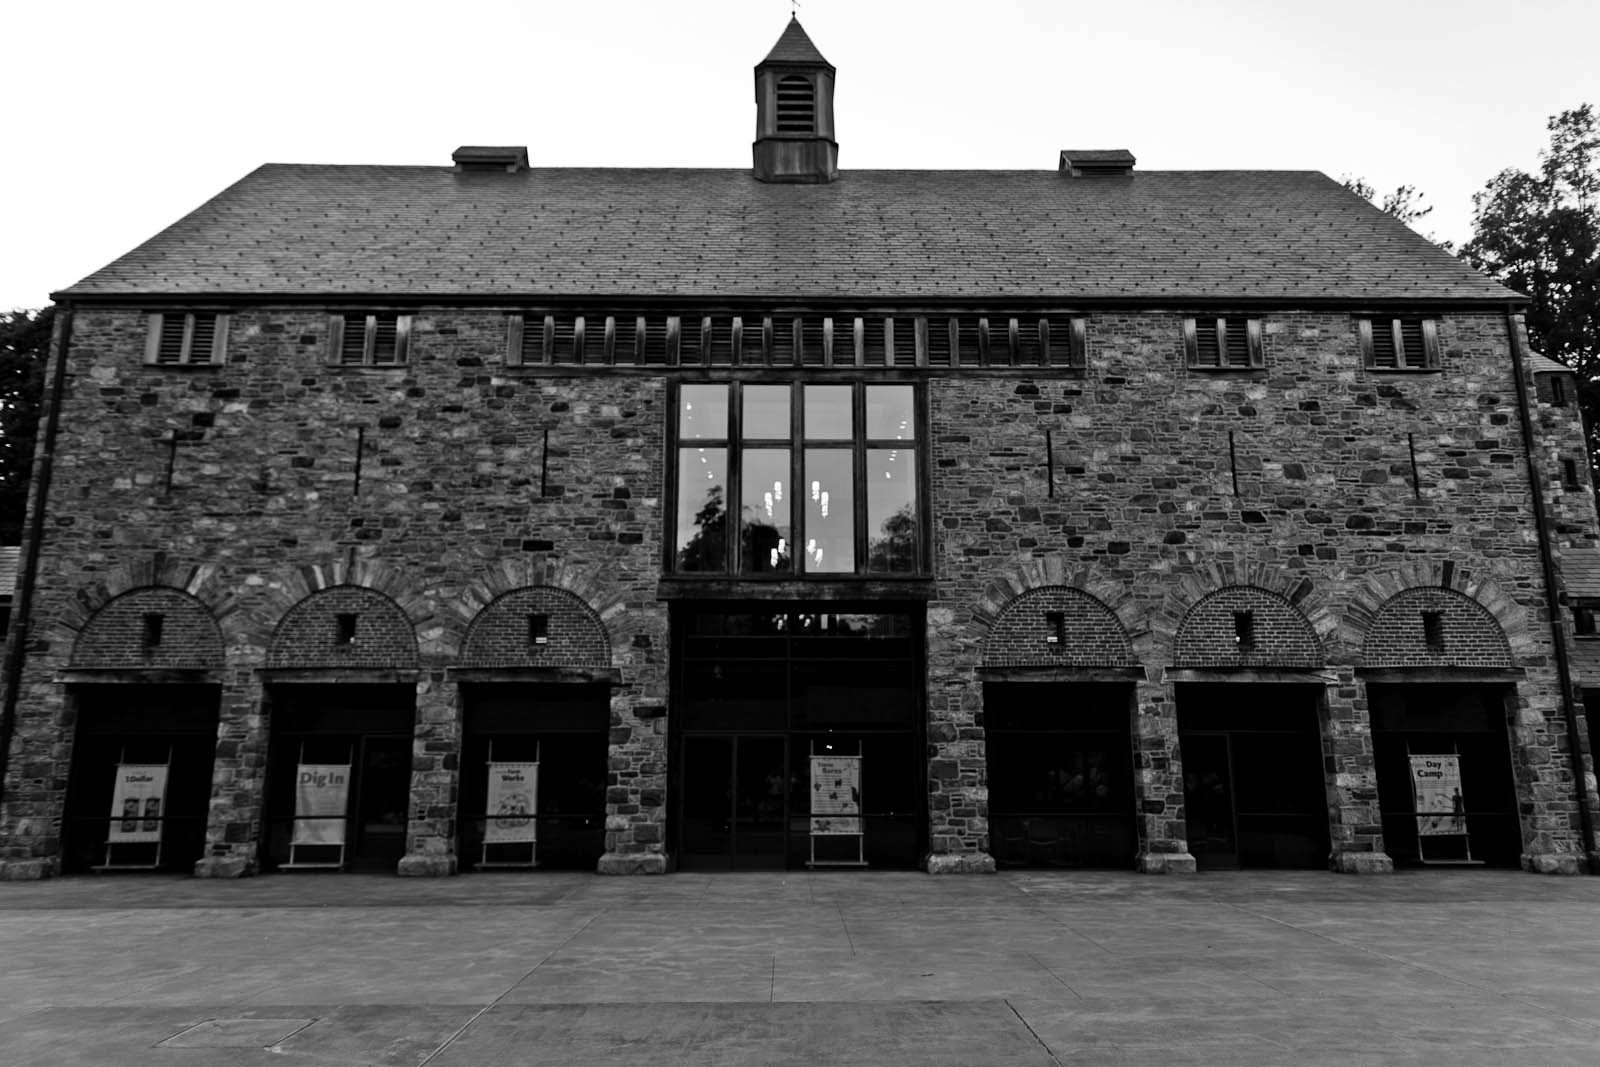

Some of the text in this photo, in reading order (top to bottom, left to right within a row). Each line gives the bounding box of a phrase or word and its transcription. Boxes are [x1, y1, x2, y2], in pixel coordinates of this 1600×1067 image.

[1426, 761, 1441, 769] Day
[1417, 770, 1443, 779] Camp
[299, 771, 344, 788] Dig In
